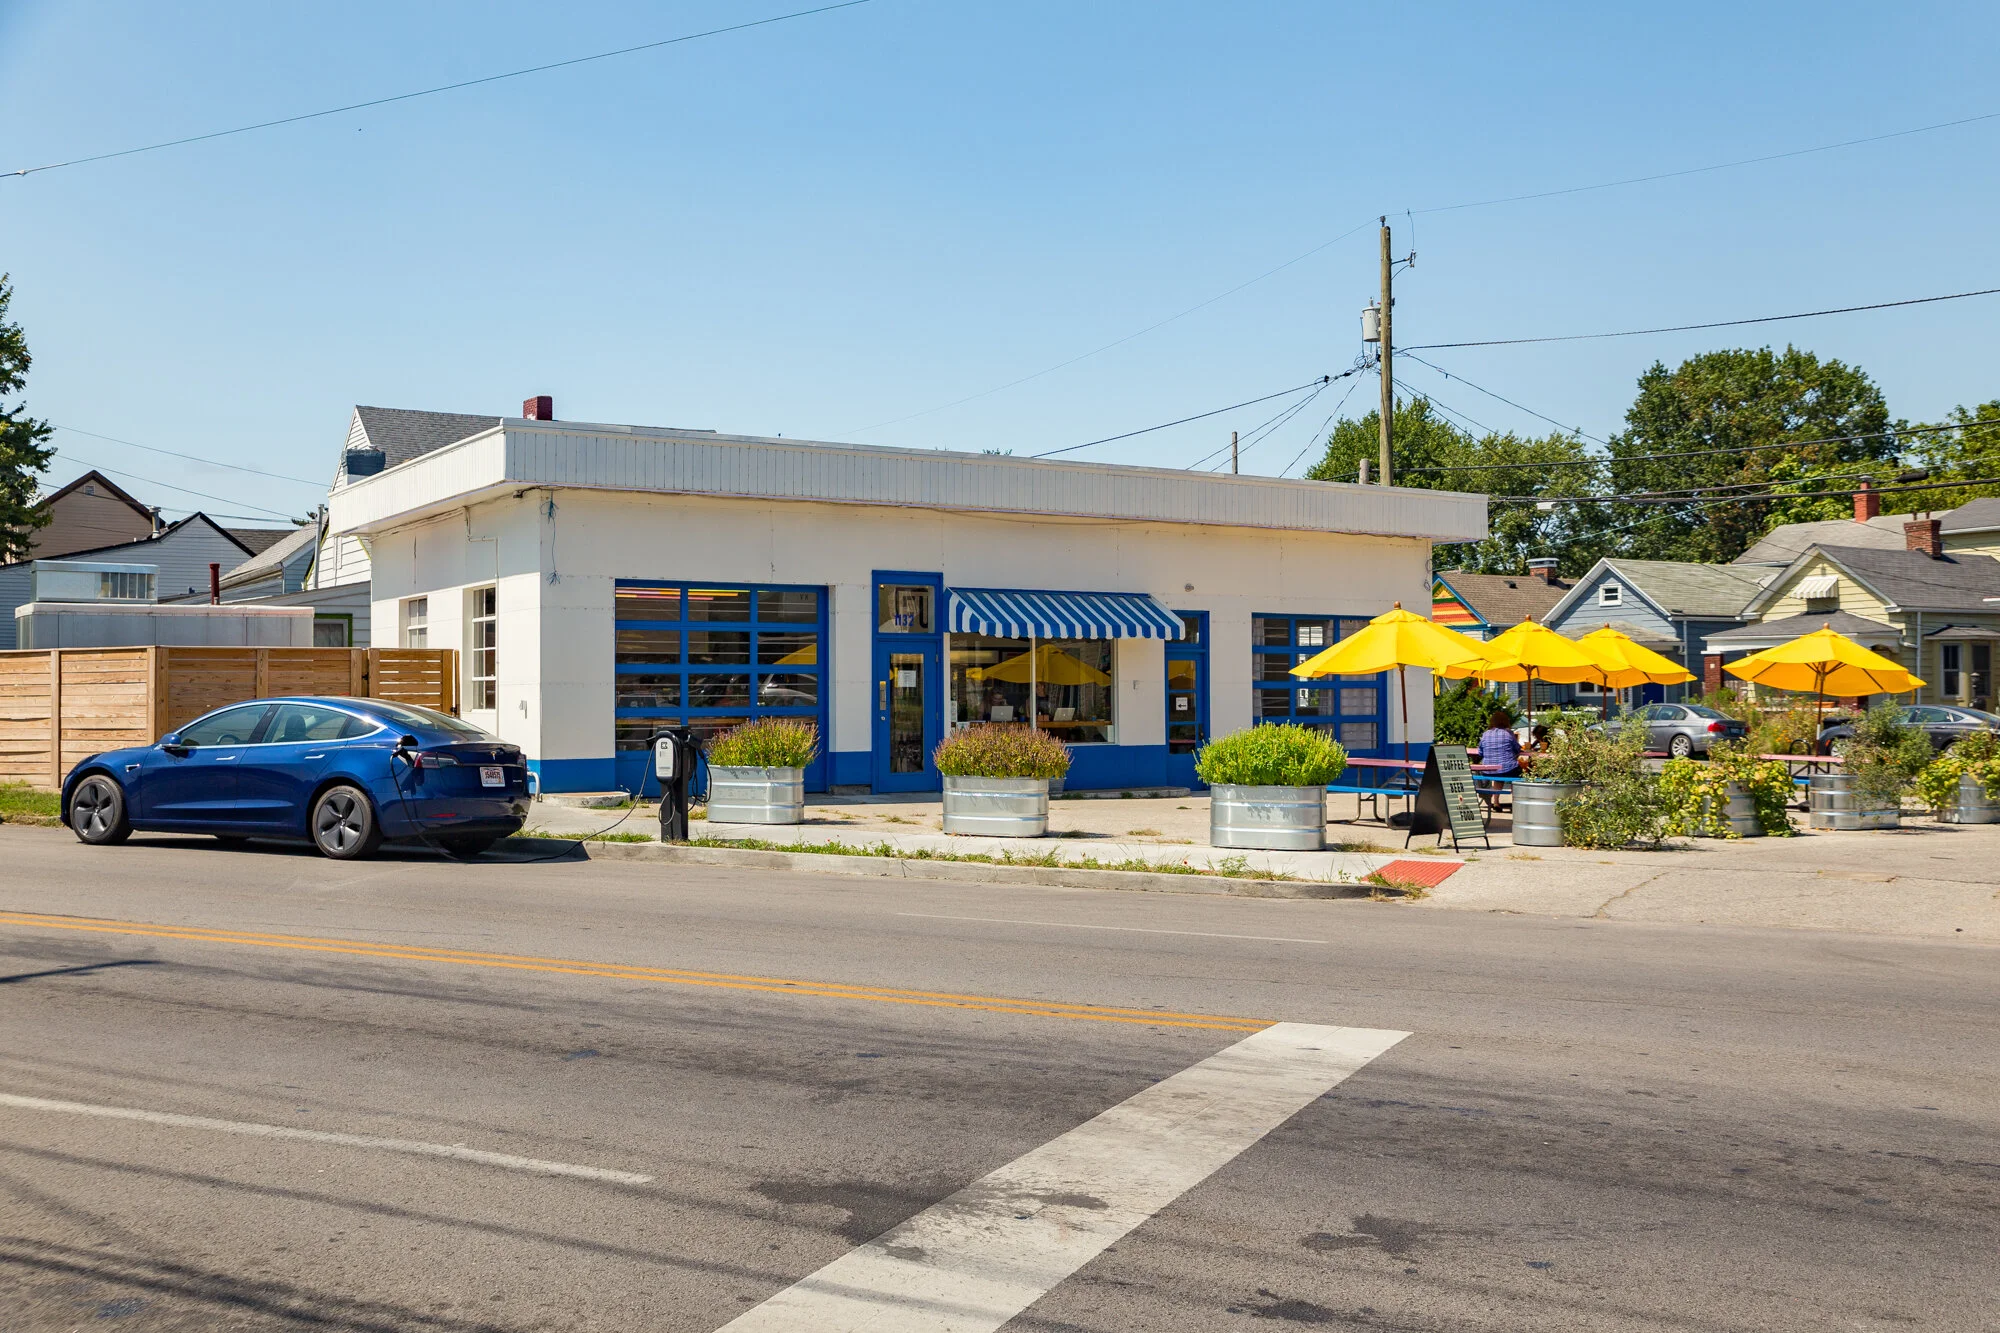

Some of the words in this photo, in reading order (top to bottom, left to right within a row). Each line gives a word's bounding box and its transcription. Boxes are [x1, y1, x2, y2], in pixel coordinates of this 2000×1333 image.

[895, 614, 914, 626] 1132
[1443, 760, 1464, 770] COFFEE
[1450, 783, 1464, 793] BEER
[1460, 811, 1474, 821] FOOD
